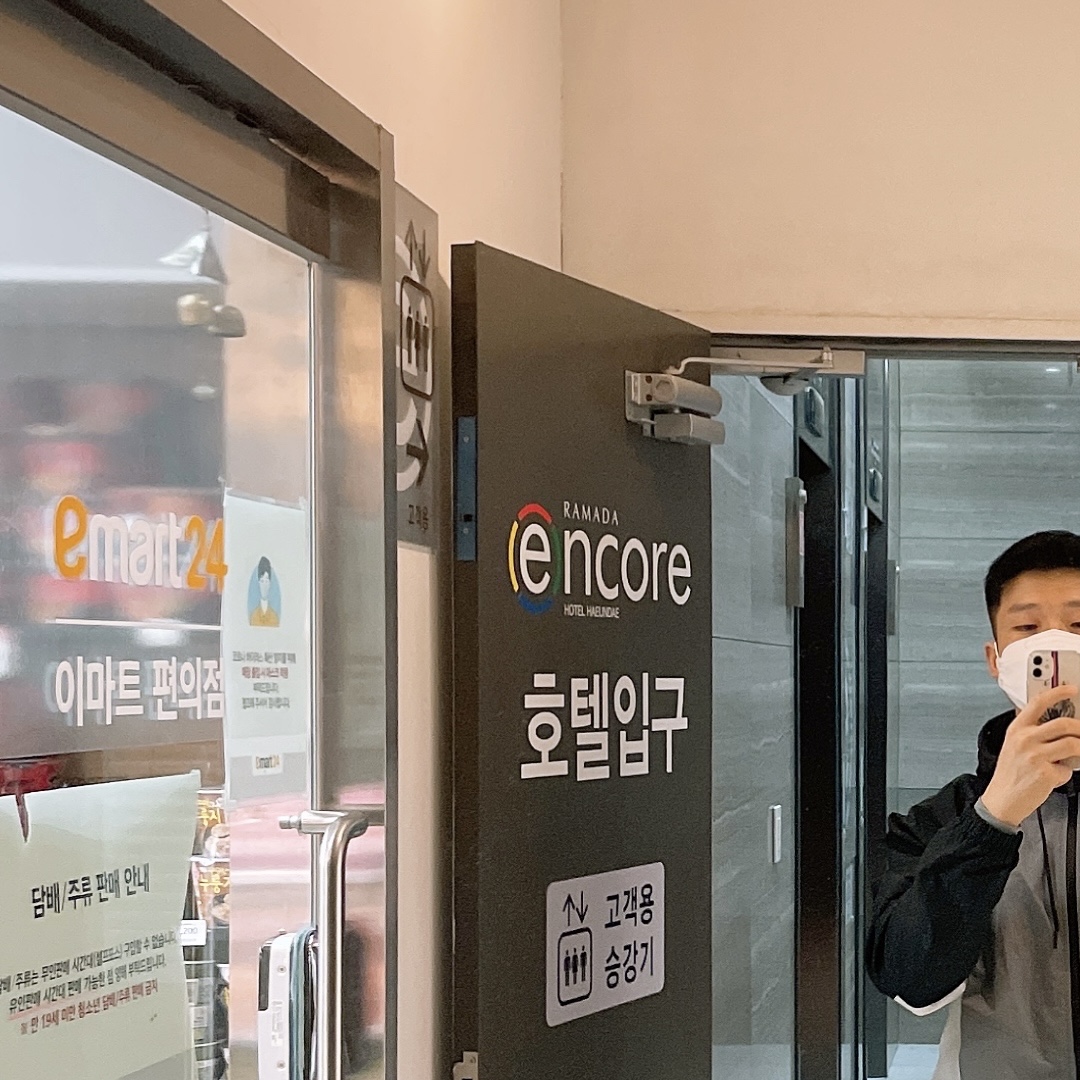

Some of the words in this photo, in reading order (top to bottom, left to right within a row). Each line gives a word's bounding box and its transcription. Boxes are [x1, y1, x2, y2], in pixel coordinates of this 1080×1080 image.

[563, 501, 619, 526] RAMADA
[53, 494, 228, 592] emart24
[519, 523, 692, 605] encore
[563, 604, 586, 617] HOTEL
[55, 656, 144, 727] 이마트
[152, 656, 224, 720] 편의점
[520, 672, 689, 782] 호텔입구
[31, 875, 93, 919] 담배/주류
[95, 868, 120, 903] 판매
[124, 862, 150, 896] 안내
[604, 883, 654, 929] 고객용
[604, 936, 653, 989] 승강기
